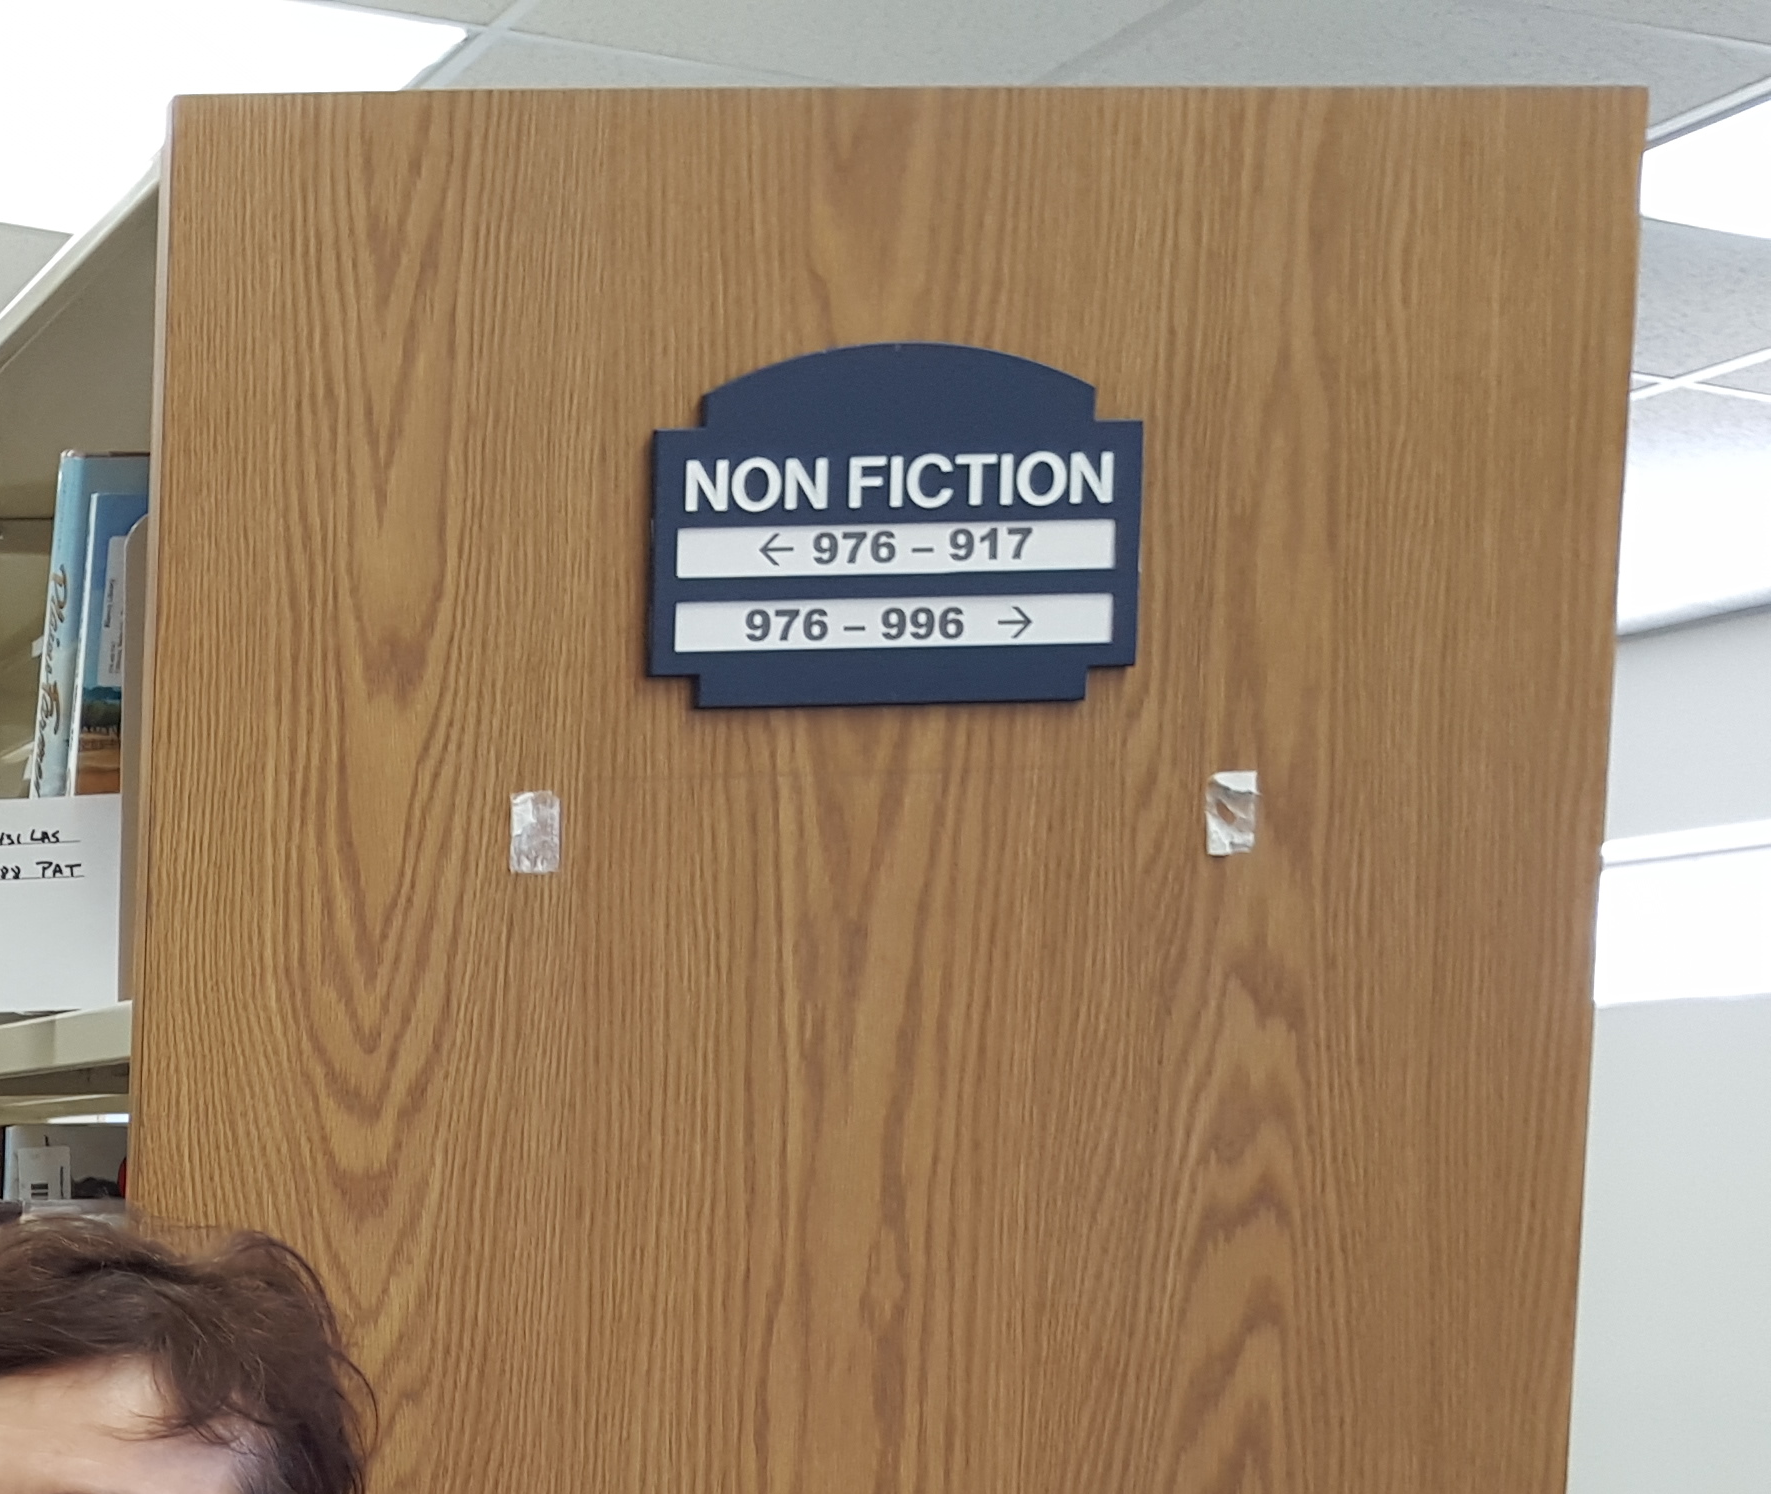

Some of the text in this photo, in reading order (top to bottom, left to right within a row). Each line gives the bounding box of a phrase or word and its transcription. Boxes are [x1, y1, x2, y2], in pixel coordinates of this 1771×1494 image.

[684, 451, 1115, 513] NON FICTION
[812, 527, 1033, 566] 976 917
[745, 606, 965, 643] 976 996
[36, 861, 82, 878] PAT
